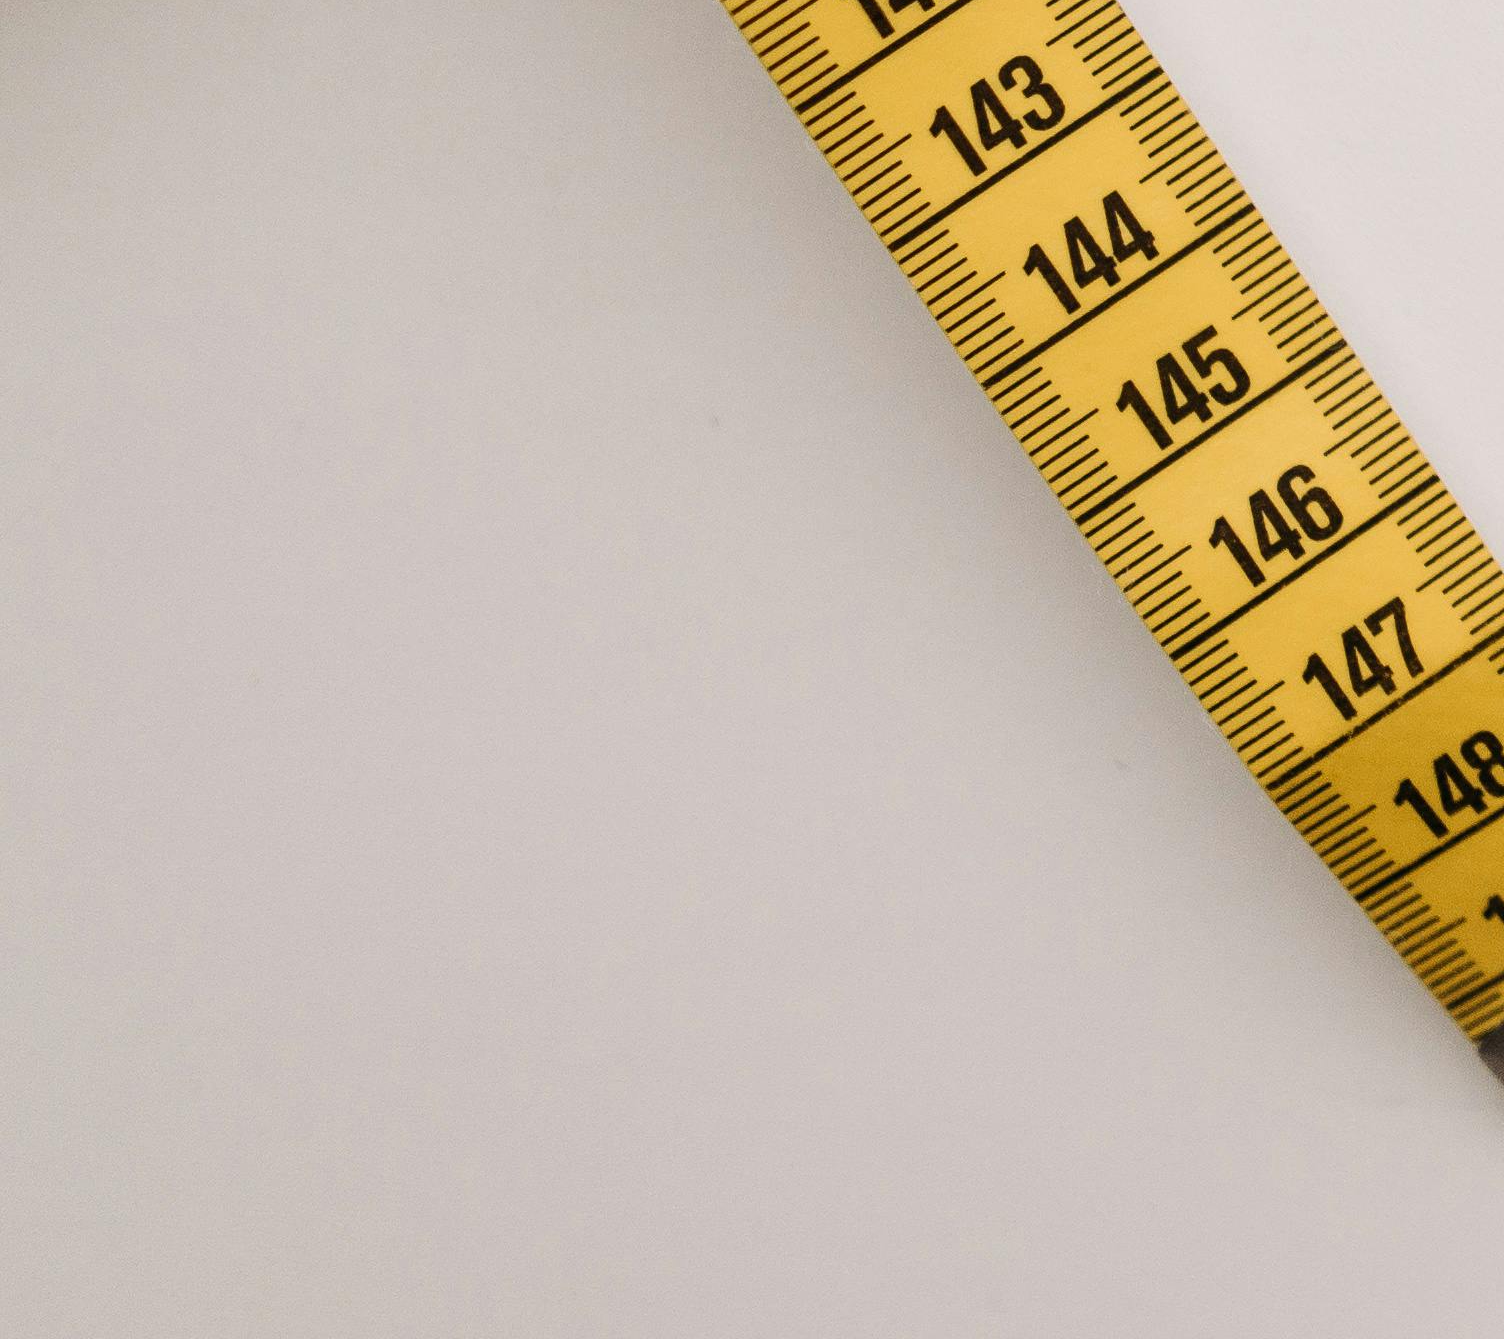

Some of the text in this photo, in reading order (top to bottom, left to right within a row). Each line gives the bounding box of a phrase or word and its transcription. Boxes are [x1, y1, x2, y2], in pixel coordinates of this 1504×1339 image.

[929, 55, 1066, 177] 143
[1023, 190, 1159, 315] 144
[1115, 324, 1251, 450] 145
[1209, 464, 1344, 587] 146
[1302, 596, 1425, 721] 147
